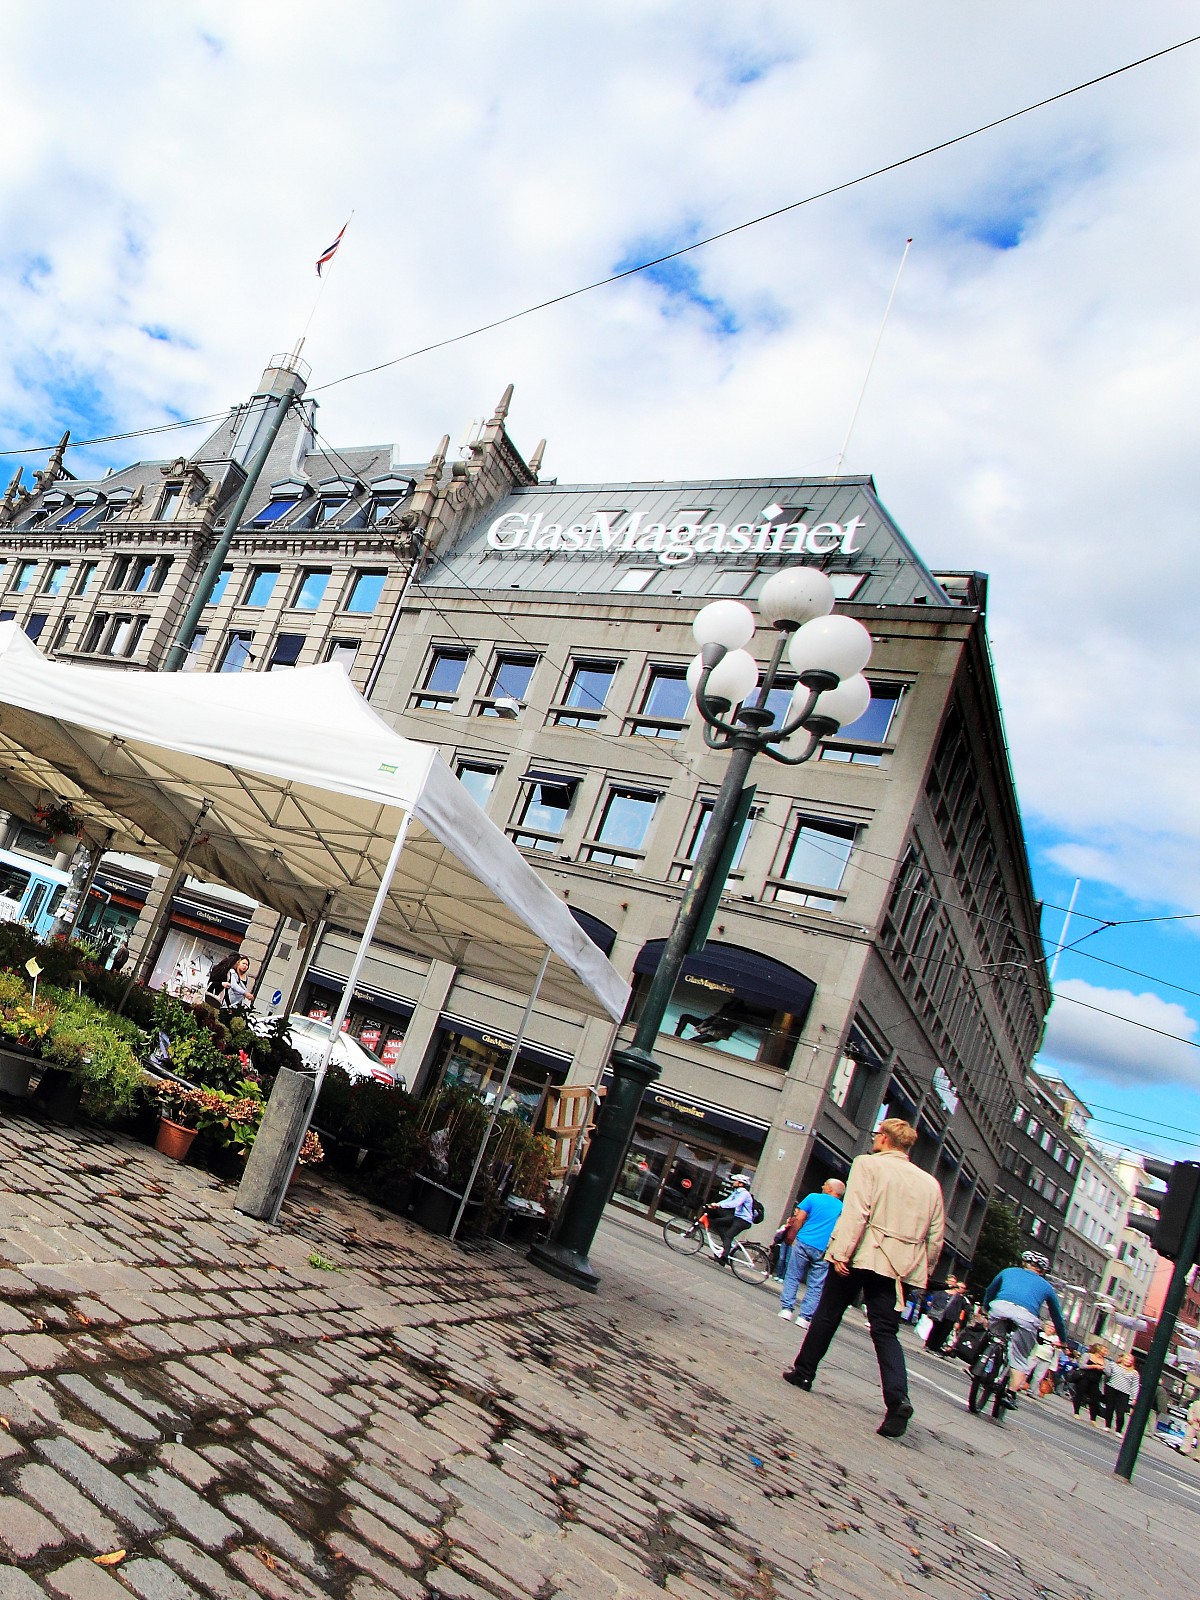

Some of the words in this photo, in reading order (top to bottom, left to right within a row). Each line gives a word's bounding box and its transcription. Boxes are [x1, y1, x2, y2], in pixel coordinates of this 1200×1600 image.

[487, 503, 866, 564] GlasMagasinet
[685, 974, 735, 993] GlasMagasinet
[309, 1011, 323, 1019] SALE
[362, 1031, 377, 1039] SALE
[387, 1040, 402, 1048] SALE
[655, 1095, 705, 1119] GlasMagasinet
